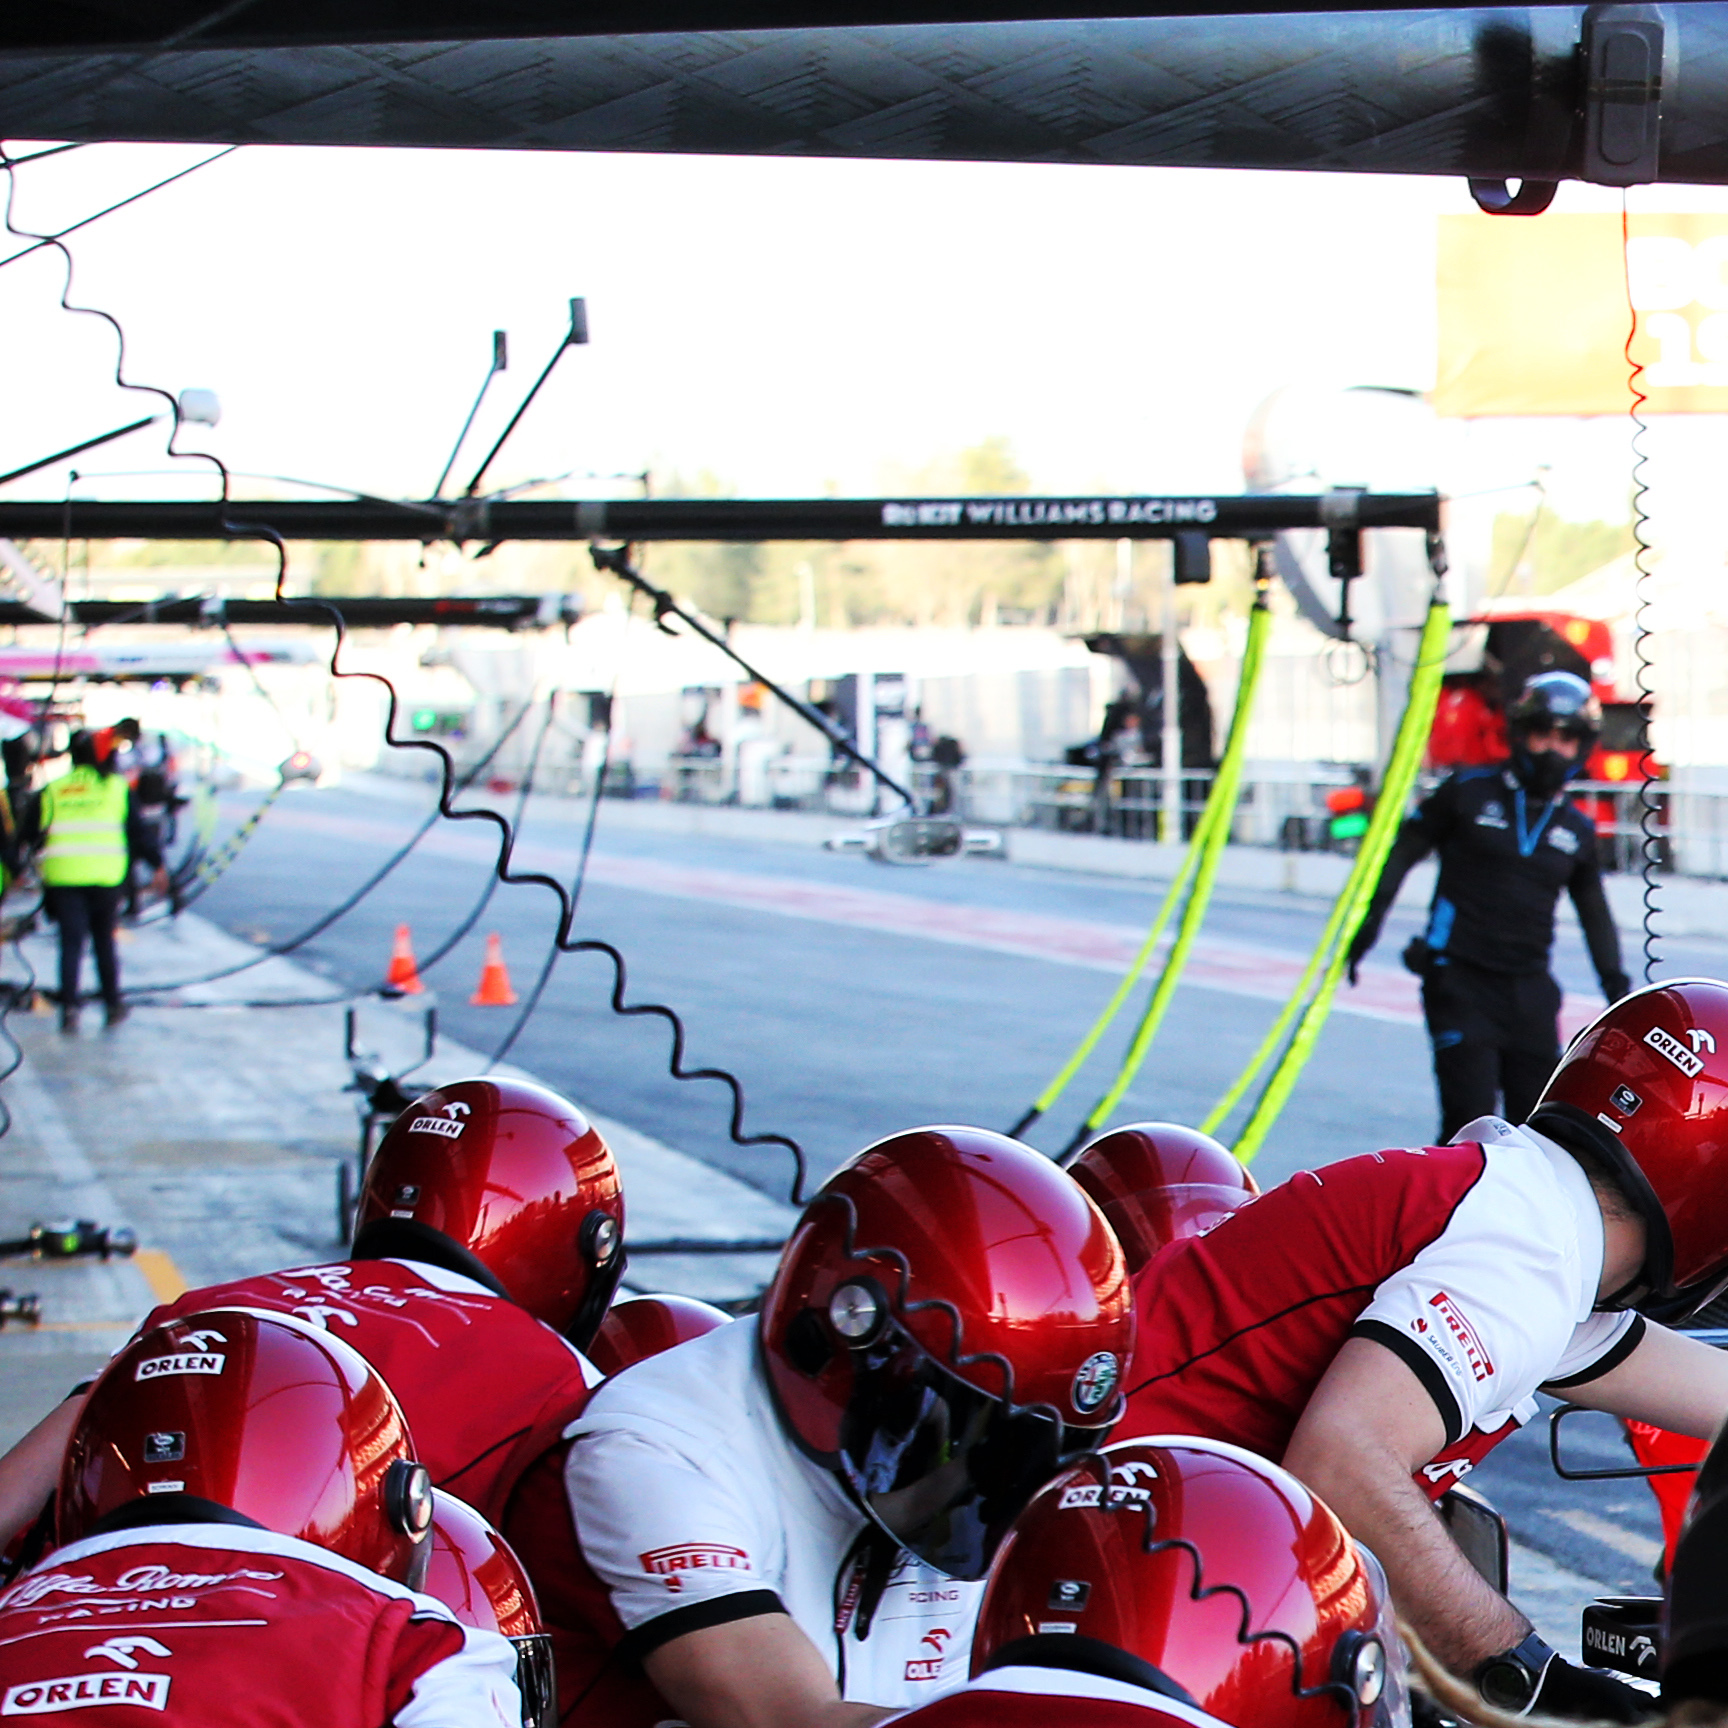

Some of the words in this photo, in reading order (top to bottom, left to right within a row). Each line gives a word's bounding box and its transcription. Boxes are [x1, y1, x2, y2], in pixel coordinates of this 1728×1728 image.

[966, 502, 1105, 524] WILLIAMS
[1107, 499, 1217, 523] RACING
[1650, 1031, 1698, 1073] ORLEN
[414, 1120, 458, 1134] ORLEN
[1429, 1291, 1494, 1382] PIRELLI
[141, 1357, 217, 1376] ORLEN
[1066, 1489, 1143, 1506] OREN
[638, 1542, 751, 1575] PIRELLI
[1586, 1628, 1625, 1656] ORLEN
[14, 1678, 157, 1707] ORLEN
